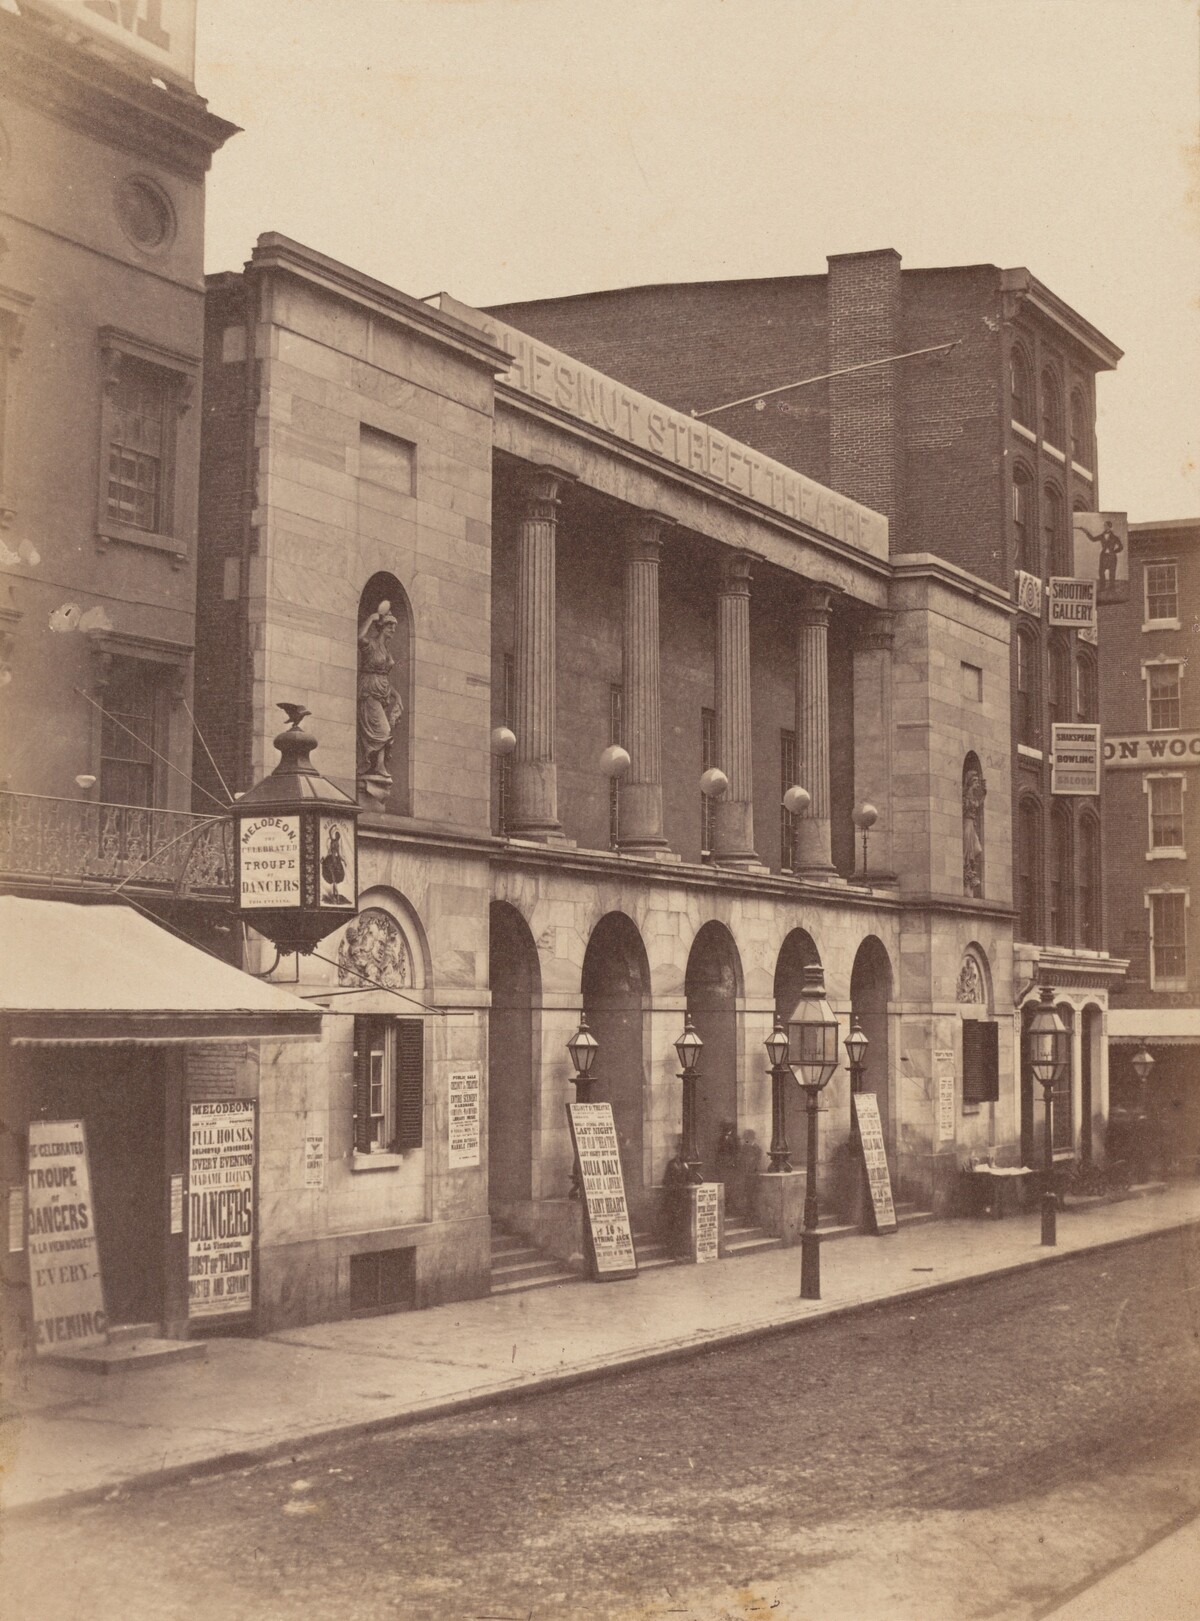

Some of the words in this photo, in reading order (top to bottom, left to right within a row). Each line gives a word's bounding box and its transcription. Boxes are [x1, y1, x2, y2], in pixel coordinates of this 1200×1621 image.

[648, 412, 760, 499] STREET
[764, 465, 871, 553] THEATRE
[1052, 582, 1093, 600] SHOOTING
[1056, 733, 1096, 742] SHAKSPEARE
[1056, 754, 1094, 764] BOWLING
[1056, 776, 1095, 786] SALOON
[242, 844, 298, 854] CELEBRATED
[244, 859, 295, 871] TROUPE
[242, 880, 300, 894] DANCERS
[192, 1130, 215, 1146] FULL
[217, 1127, 253, 1145] HOUSES
[576, 1127, 592, 1135] LAST
[593, 1126, 614, 1135] NIGHT
[39, 1141, 84, 1157] CELEBRATED
[595, 1135, 616, 1149] THEATRE
[192, 1156, 218, 1171] EVERY
[219, 1153, 253, 1169] EVENING
[583, 1160, 602, 1176] JULIA
[602, 1159, 619, 1175] DALY
[29, 1166, 77, 1190] TROUPE
[191, 1171, 221, 1186] MADAME
[588, 1198, 605, 1214] FAINT
[605, 1197, 625, 1213] HEART
[29, 1203, 89, 1235] DANCERS
[190, 1187, 252, 1242] DANCERS
[606, 1224, 615, 1236] 16
[594, 1235, 614, 1243] STRING
[38, 1242, 48, 1253] LA
[197, 1243, 202, 1251] A
[190, 1254, 210, 1276] HOST
[218, 1250, 250, 1273] TALENT
[36, 1263, 89, 1288] EVERY
[37, 1311, 107, 1345] EVENING
